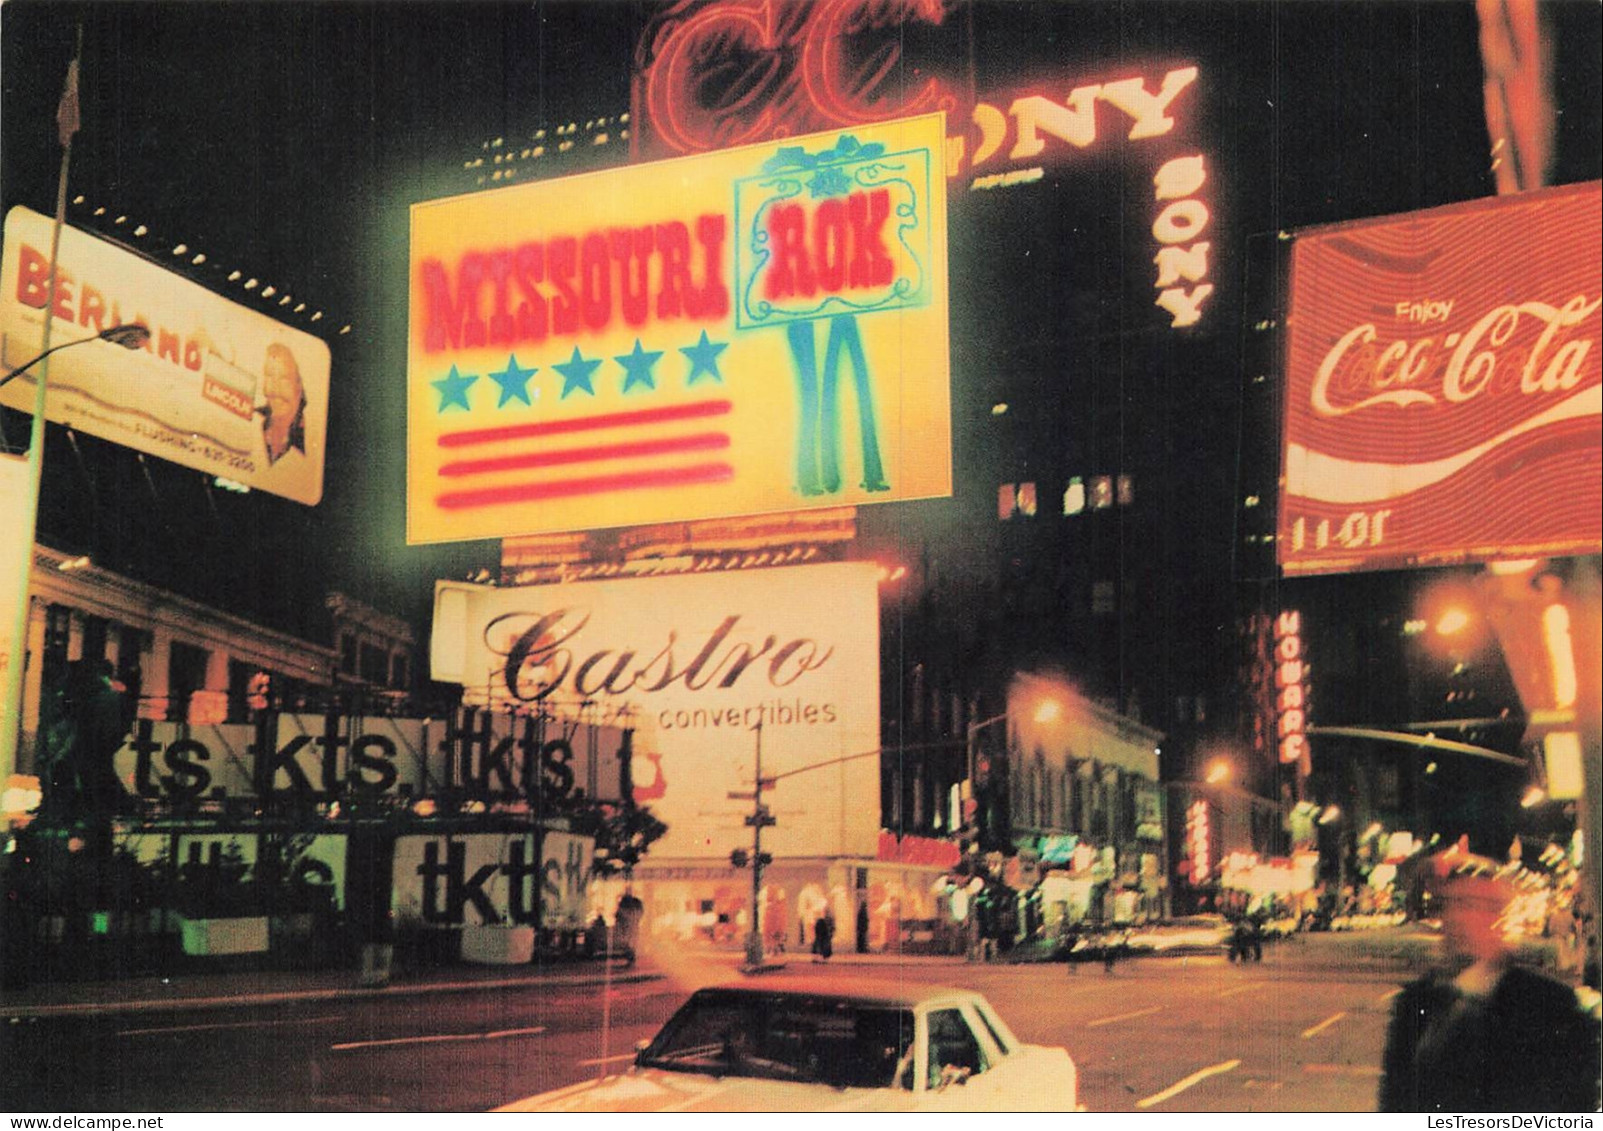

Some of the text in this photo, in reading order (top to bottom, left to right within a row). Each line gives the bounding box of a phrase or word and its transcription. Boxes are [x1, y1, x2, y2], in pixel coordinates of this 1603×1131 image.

[420, 213, 731, 353] MISSOURI
[764, 188, 894, 303] ROK
[1152, 153, 1214, 328] SONY
[1395, 299, 1454, 324] Enjoy
[484, 606, 835, 701] Castro
[659, 698, 837, 730] convertibles
